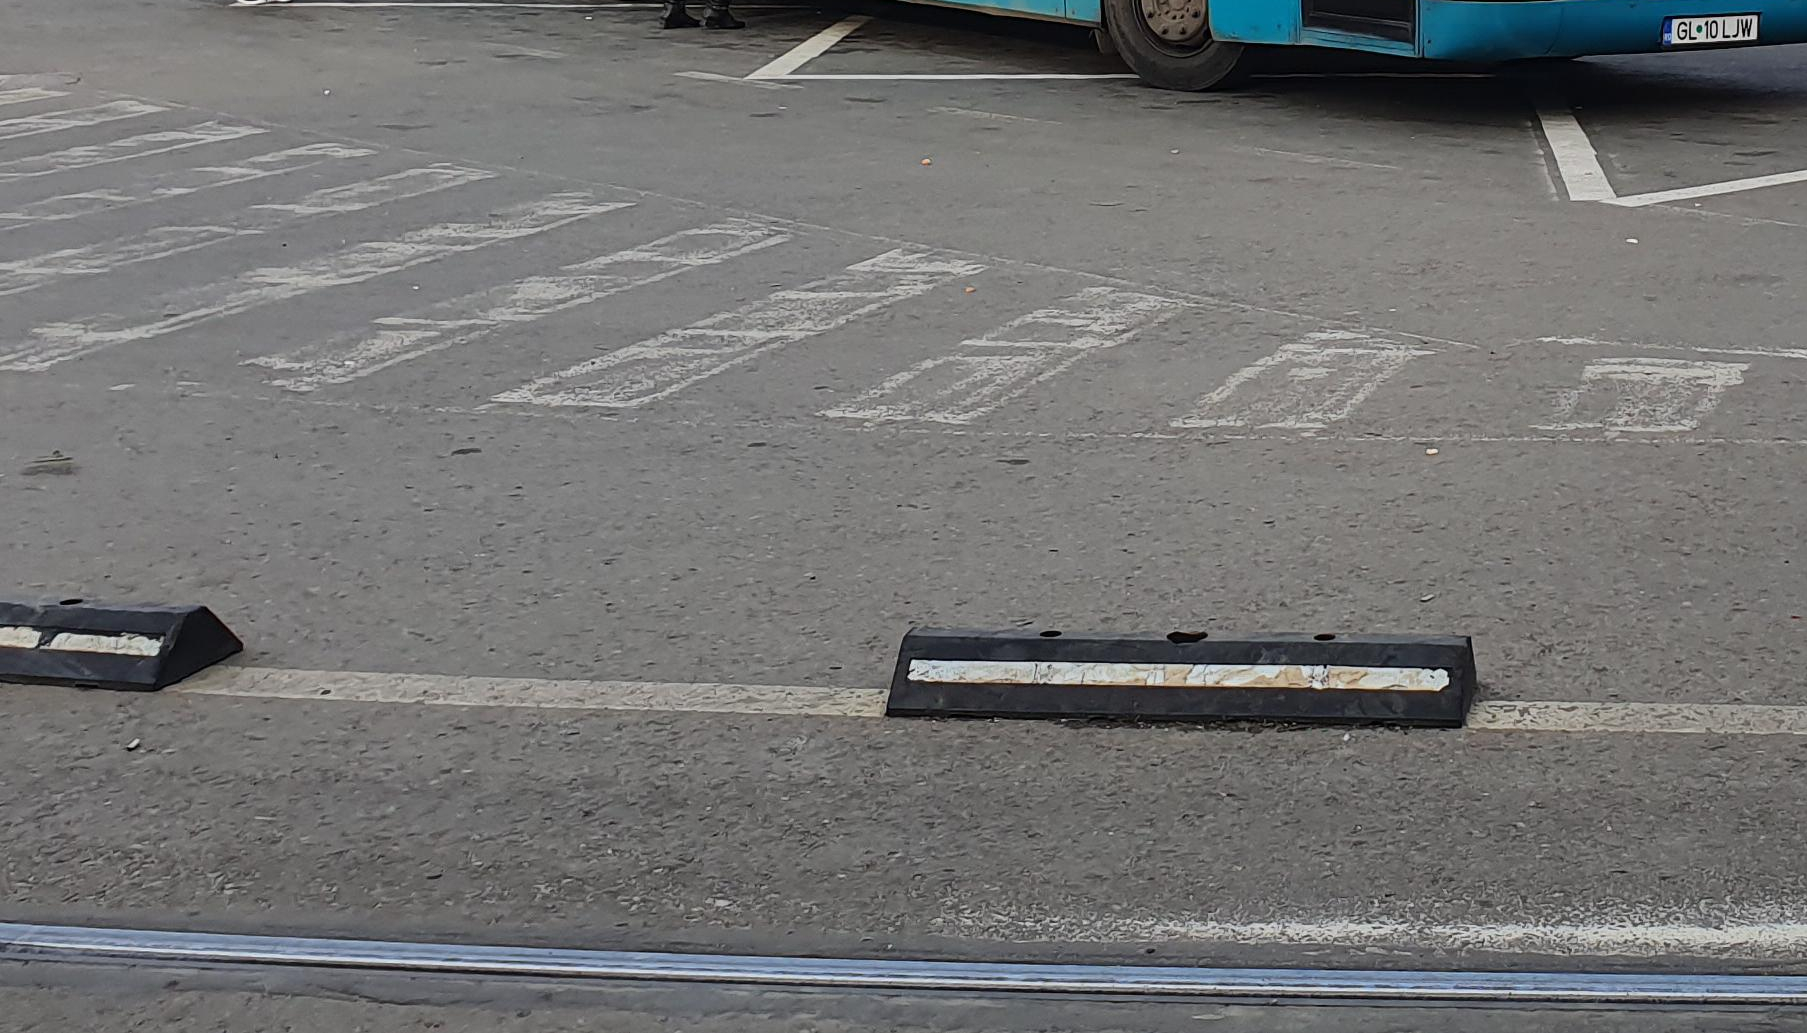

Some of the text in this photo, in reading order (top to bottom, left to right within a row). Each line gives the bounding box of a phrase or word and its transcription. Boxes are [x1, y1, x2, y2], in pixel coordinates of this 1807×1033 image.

[1677, 18, 1753, 41] GL 10 LJW
